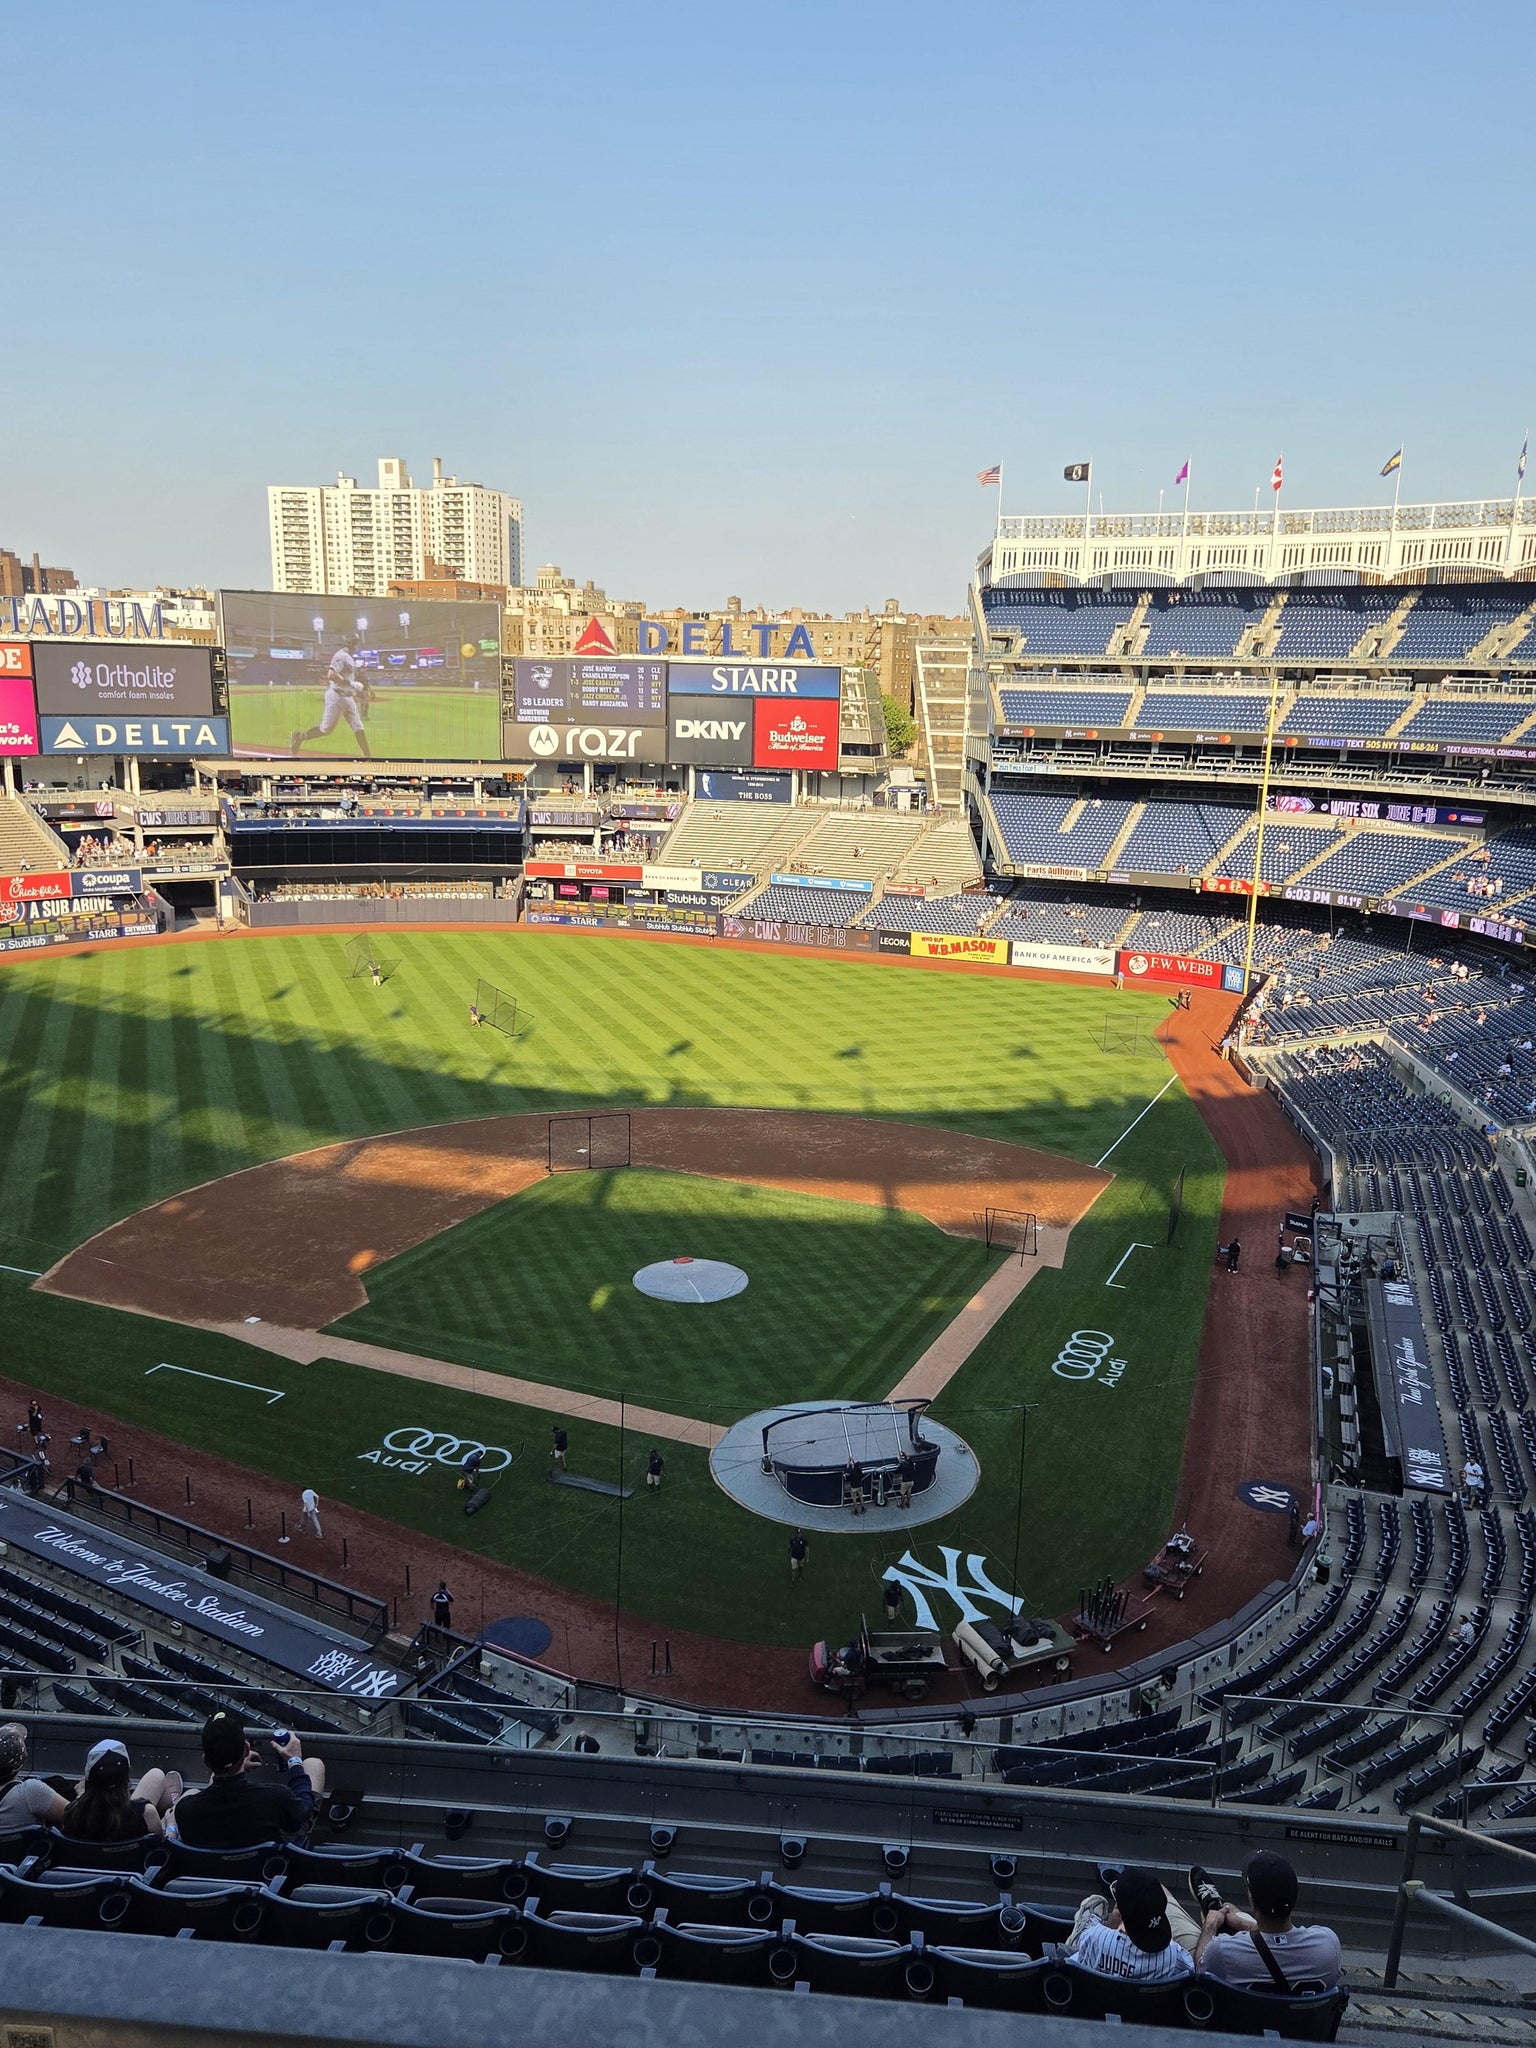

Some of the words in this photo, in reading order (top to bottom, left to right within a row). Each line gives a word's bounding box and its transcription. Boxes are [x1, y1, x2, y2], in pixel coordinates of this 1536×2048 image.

[0, 597, 166, 639] TADIUM
[638, 621, 817, 659] DELTA
[711, 667, 798, 693] STARR
[98, 691, 127, 699] comfort
[129, 691, 147, 699] foam
[150, 692, 175, 700] insoles
[522, 698, 532, 706] SB
[534, 698, 564, 706] LEADERS
[96, 724, 218, 746] DELTA
[675, 719, 747, 741] DKNY
[769, 730, 826, 744] Budweiser
[566, 728, 643, 758] razr
[768, 742, 789, 750] Made
[796, 744, 824, 752] America
[1308, 738, 1330, 746] TITAN
[1330, 739, 1346, 747] HST
[1346, 740, 1365, 748] TEXT
[1366, 740, 1382, 749] SOS
[1400, 742, 1410, 750] TO
[139, 812, 162, 825] CWS
[532, 812, 551, 825] CWS
[1330, 800, 1360, 817] WHITE
[1361, 803, 1380, 818] SOX
[1386, 805, 1410, 822] JUNE
[97, 874, 130, 885] coupa
[1048, 867, 1082, 877] Authority
[722, 878, 752, 888] CLEAR
[667, 893, 707, 905] StubHub
[1285, 889, 1311, 901] 6:03
[1313, 893, 1331, 904] PM
[30, 901, 40, 919] A
[42, 899, 70, 918] SUB
[73, 896, 114, 912] ABOVE
[571, 916, 598, 926] STARR
[646, 922, 670, 931] StubHub
[671, 924, 693, 933] StubHub
[694, 926, 717, 935] StubHb
[88, 928, 118, 939] STARR
[754, 921, 781, 941] CWS
[785, 925, 814, 945] JUNE
[817, 926, 847, 947] 16-18
[8, 936, 46, 949] StubHub
[880, 937, 910, 947] LEGORA
[1014, 951, 1038, 959] BANK
[1052, 955, 1092, 964] AMERICA
[1151, 957, 1173, 970] F.W.
[1176, 960, 1213, 976] WEBB
[1394, 1337, 1428, 1369] Yankees
[1098, 1358, 1128, 1388] Audi
[1399, 1369, 1431, 1390] York
[1400, 1386, 1422, 1405] New
[357, 1450, 432, 1475] Audi
[34, 1526, 107, 1566] Welcome
[103, 1558, 124, 1572] to
[106, 1563, 187, 1602] Yankee
[184, 1595, 264, 1637] Stadium
[315, 1654, 353, 1676] YORK
[325, 1650, 359, 1666] NEW
[306, 1664, 338, 1681] LIFE
[1300, 1830, 1318, 1839] ALERT
[1349, 1836, 1372, 1844] AND/OR
[1374, 1838, 1392, 1846] BALLS
[1098, 1954, 1136, 1979] JUDGE
